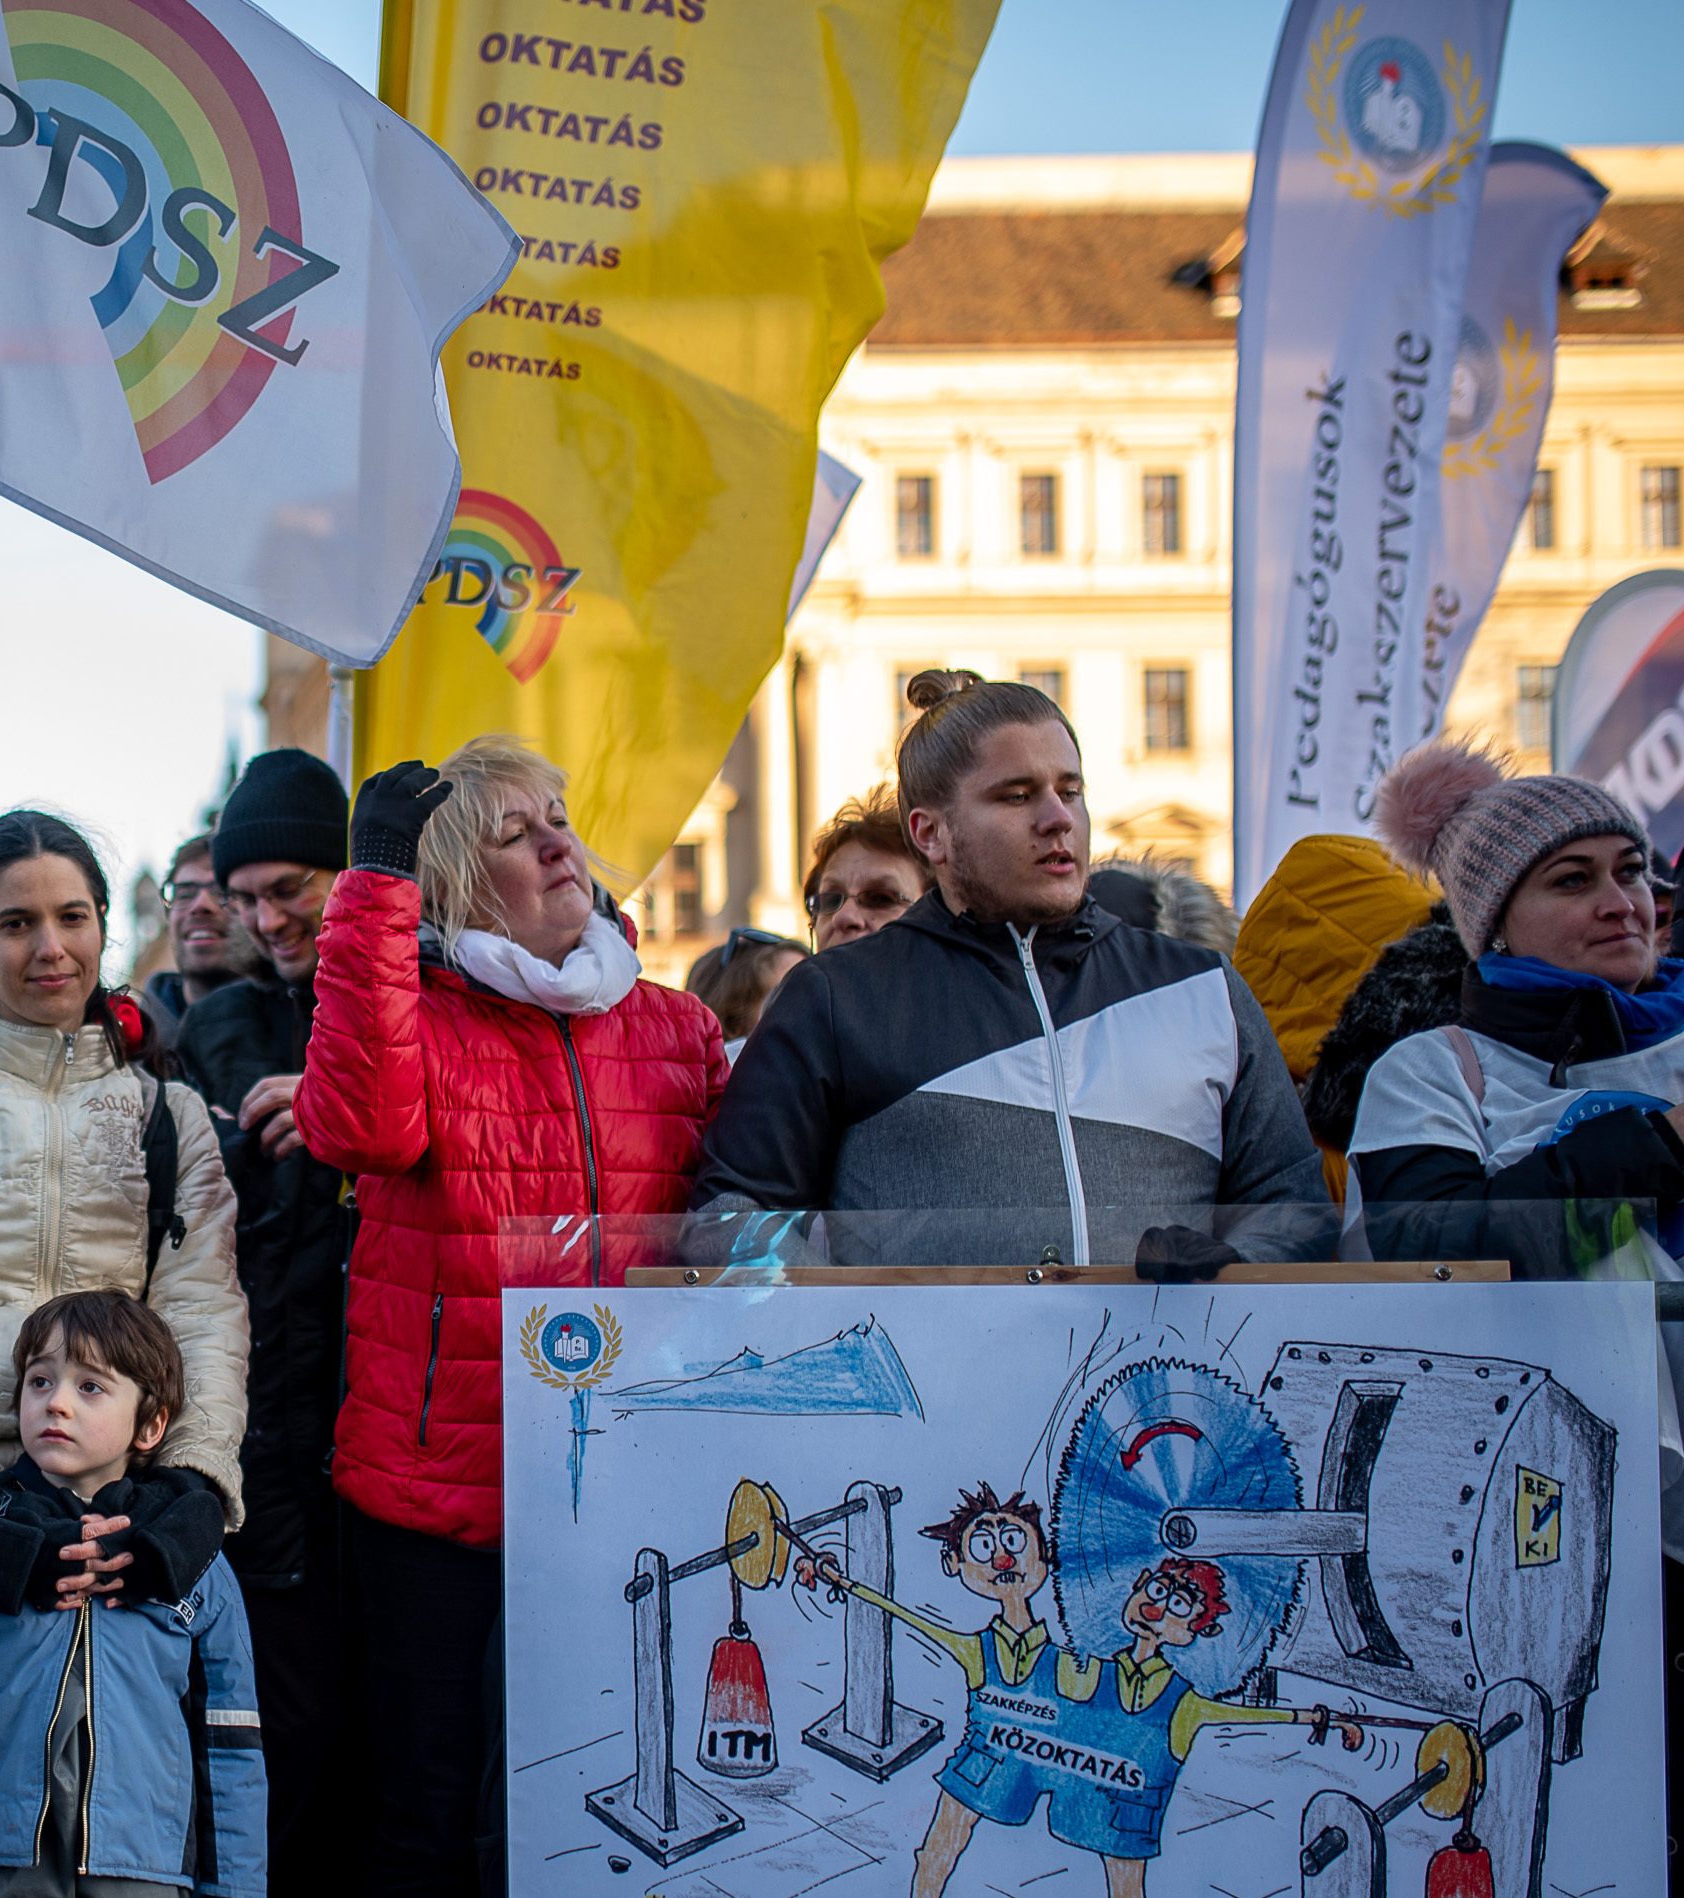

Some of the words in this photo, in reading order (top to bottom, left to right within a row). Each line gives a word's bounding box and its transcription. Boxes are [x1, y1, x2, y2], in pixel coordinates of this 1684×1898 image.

[478, 31, 686, 88] OKTATÁS
[476, 100, 664, 151] OKTATÁS
[474, 166, 642, 211] OKTATÁS
[522, 234, 622, 271] TATÁS
[467, 350, 583, 381] OKTATÁS
[1524, 1477, 1549, 1498] BE
[1525, 1540, 1549, 1558] KI
[975, 1691, 1058, 1722] SZAKKÉPZÉS
[707, 1729, 773, 1763] ITM
[989, 1725, 1143, 1789] KÖZOKTATÁS
